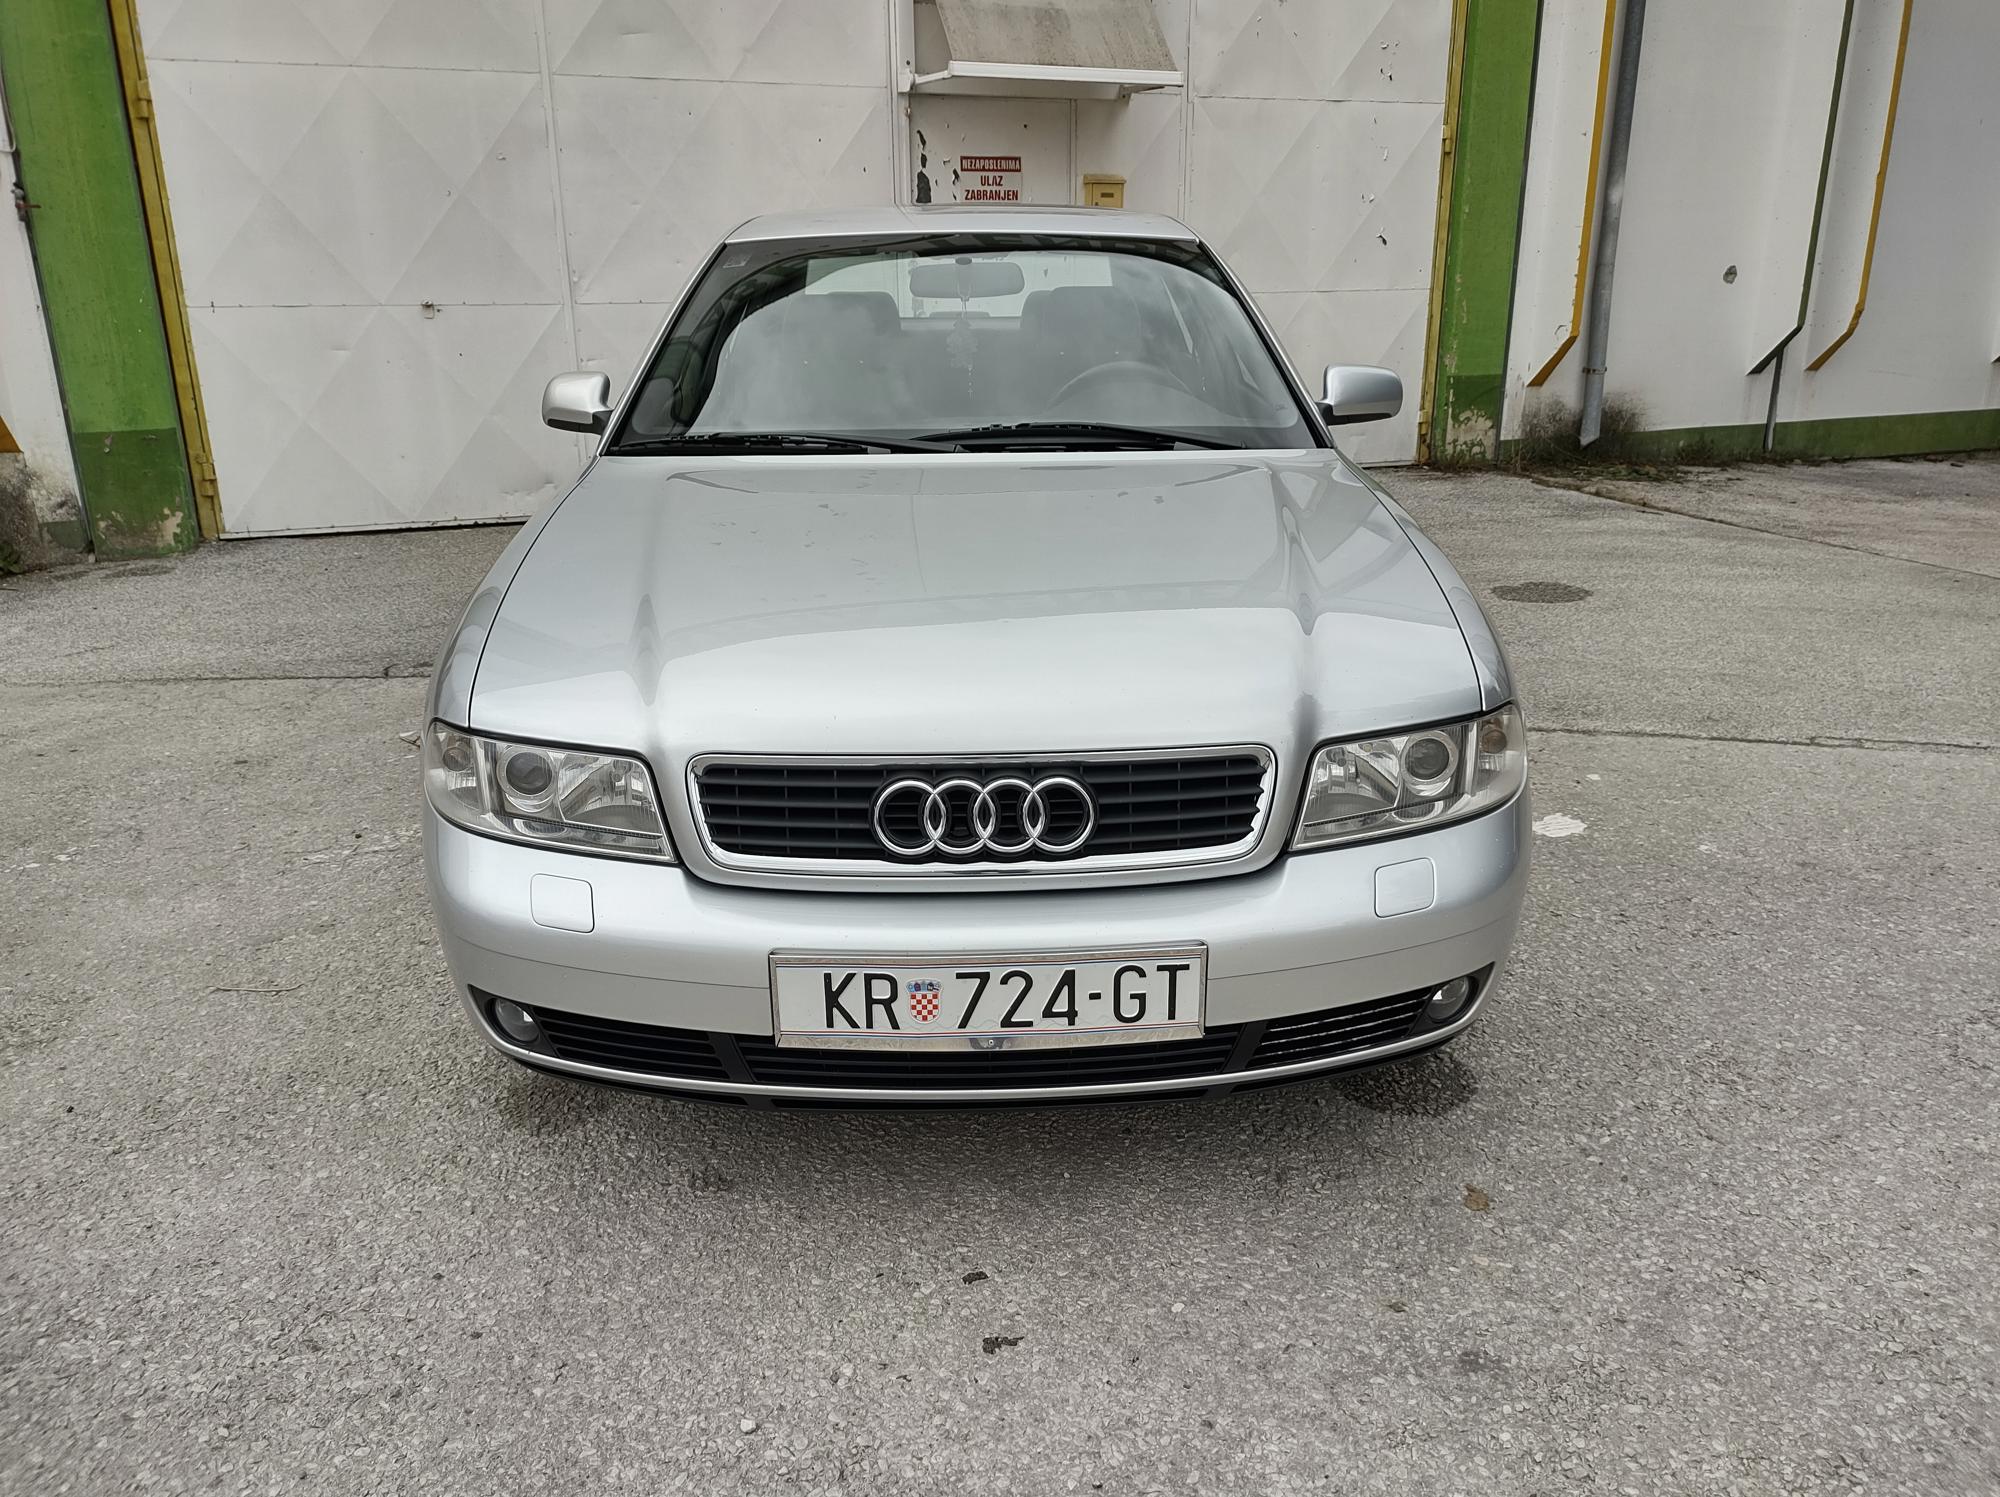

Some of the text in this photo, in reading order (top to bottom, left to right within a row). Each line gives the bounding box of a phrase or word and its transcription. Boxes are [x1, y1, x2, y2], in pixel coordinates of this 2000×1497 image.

[962, 159, 1020, 170] NEZAPOSLENIMA
[980, 175, 1004, 187] ULAZ
[964, 189, 1019, 201] ZABRANJEN
[823, 964, 1190, 1030] KR 724-GT
